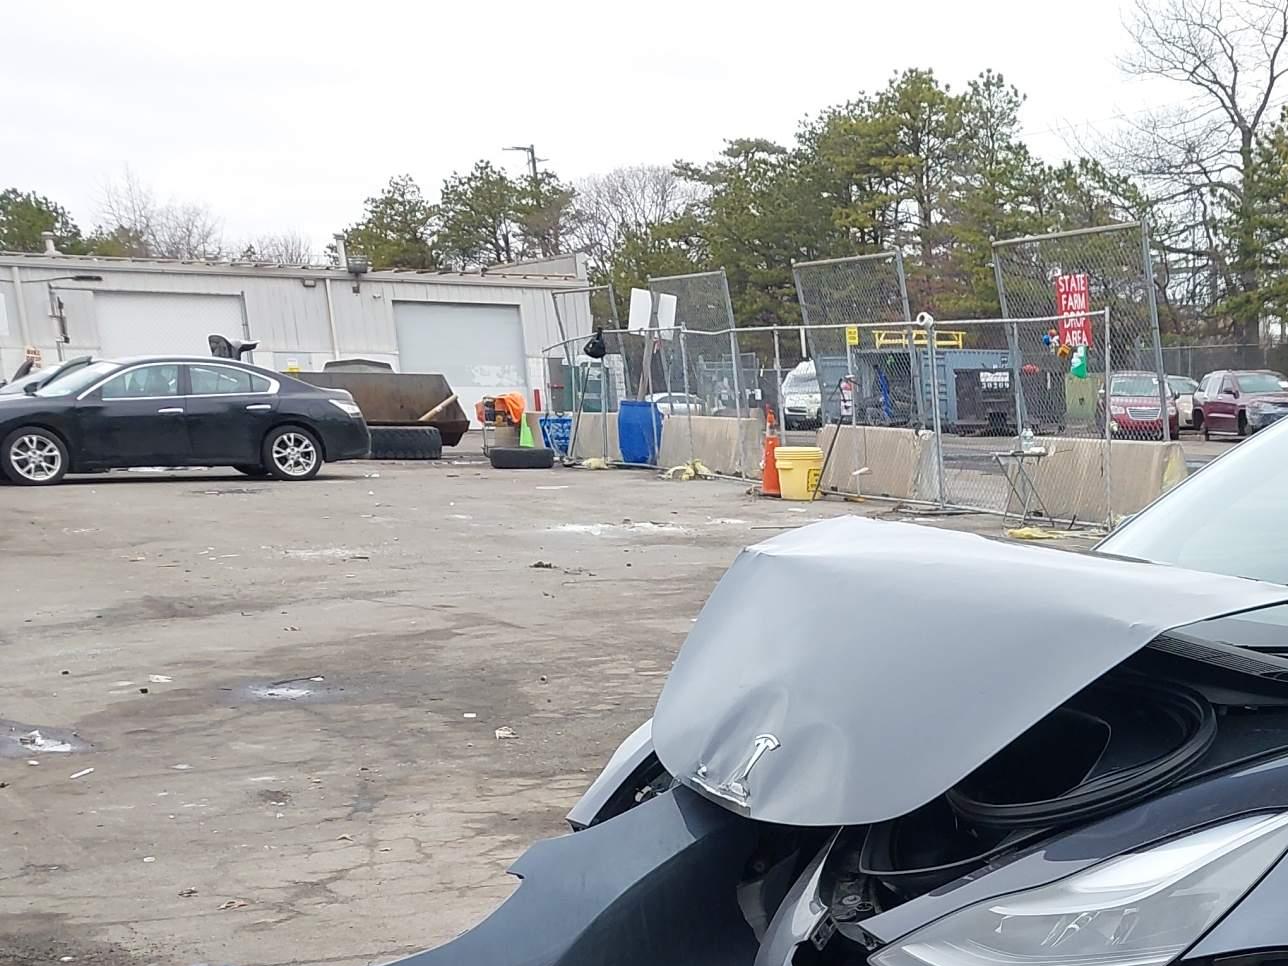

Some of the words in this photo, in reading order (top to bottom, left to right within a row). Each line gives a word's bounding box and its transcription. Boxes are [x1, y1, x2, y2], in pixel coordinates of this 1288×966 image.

[1058, 273, 1086, 293] STATE
[1061, 292, 1086, 311] FARM
[1063, 310, 1086, 329] DROP
[1065, 330, 1088, 347] AREA
